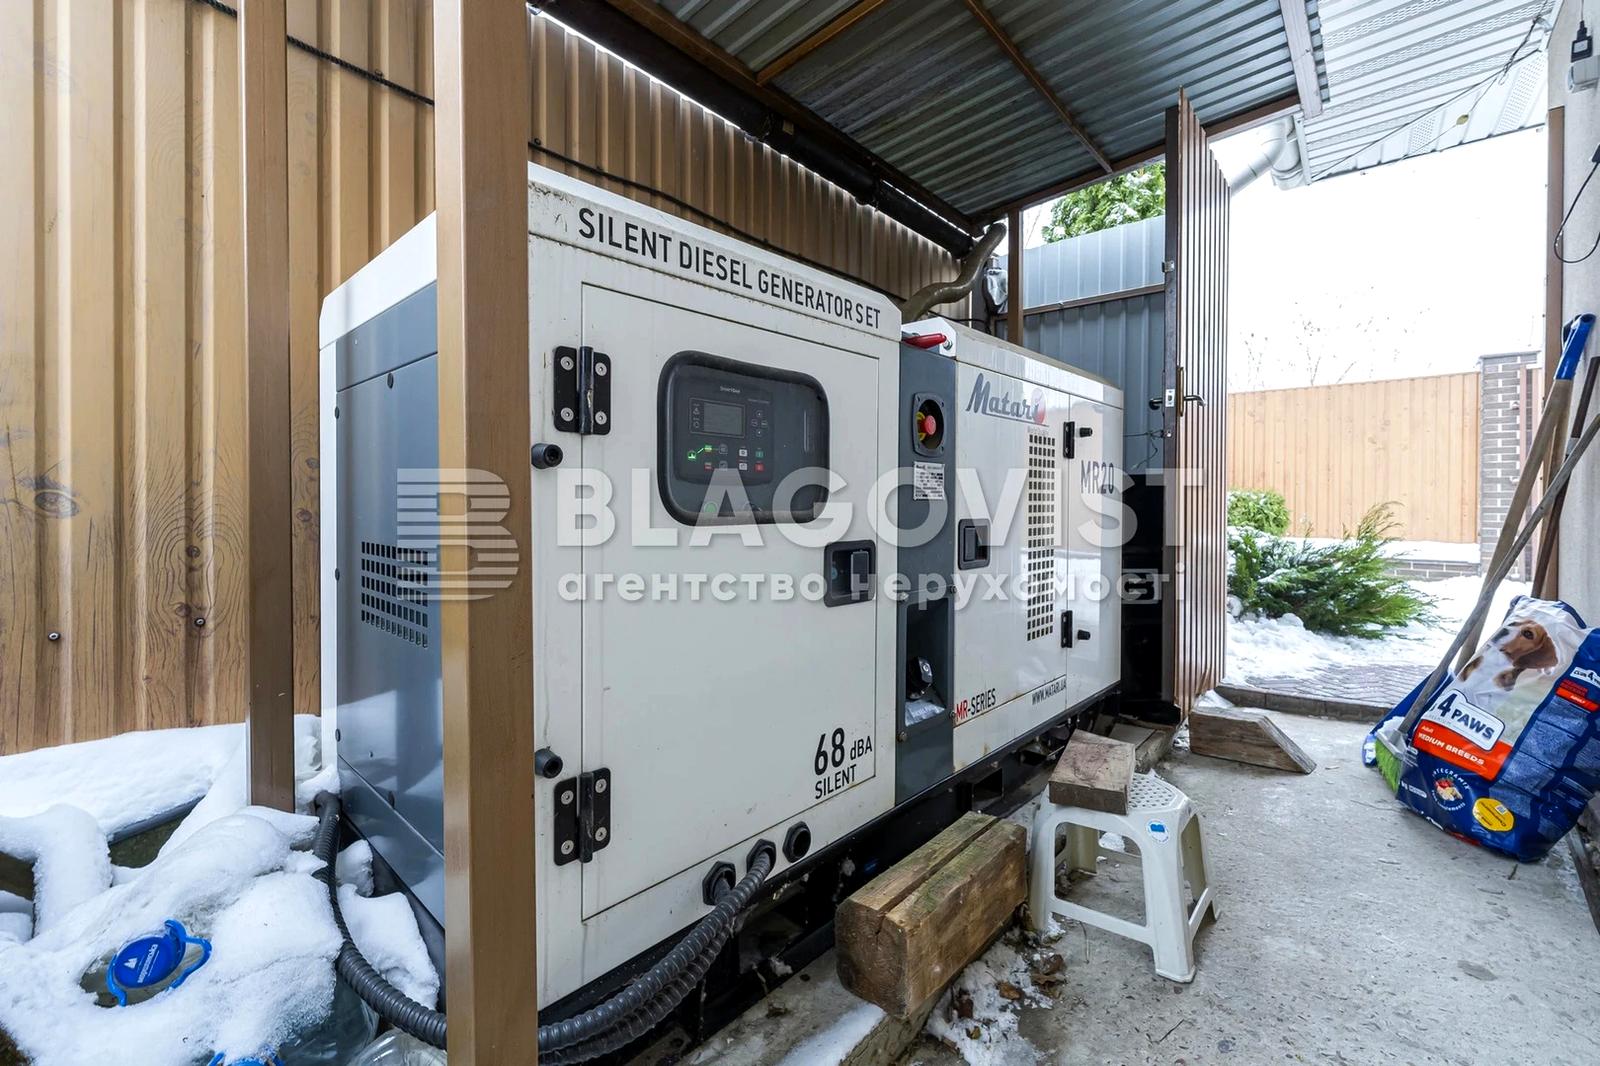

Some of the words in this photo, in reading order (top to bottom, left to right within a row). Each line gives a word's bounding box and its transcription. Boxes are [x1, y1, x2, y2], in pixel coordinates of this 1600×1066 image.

[578, 207, 672, 263] SILENT
[679, 240, 753, 290] DIESEL
[758, 269, 853, 321] GENERATOR
[1080, 459, 1115, 494] MR20
[955, 688, 997, 722] MR-SERIES
[1437, 693, 1458, 718] 4
[1450, 708, 1495, 740] PAWS
[813, 727, 845, 776] 68
[850, 735, 873, 761] dBA
[1445, 744, 1486, 765] BREEDS
[815, 763, 857, 800] SILENT
